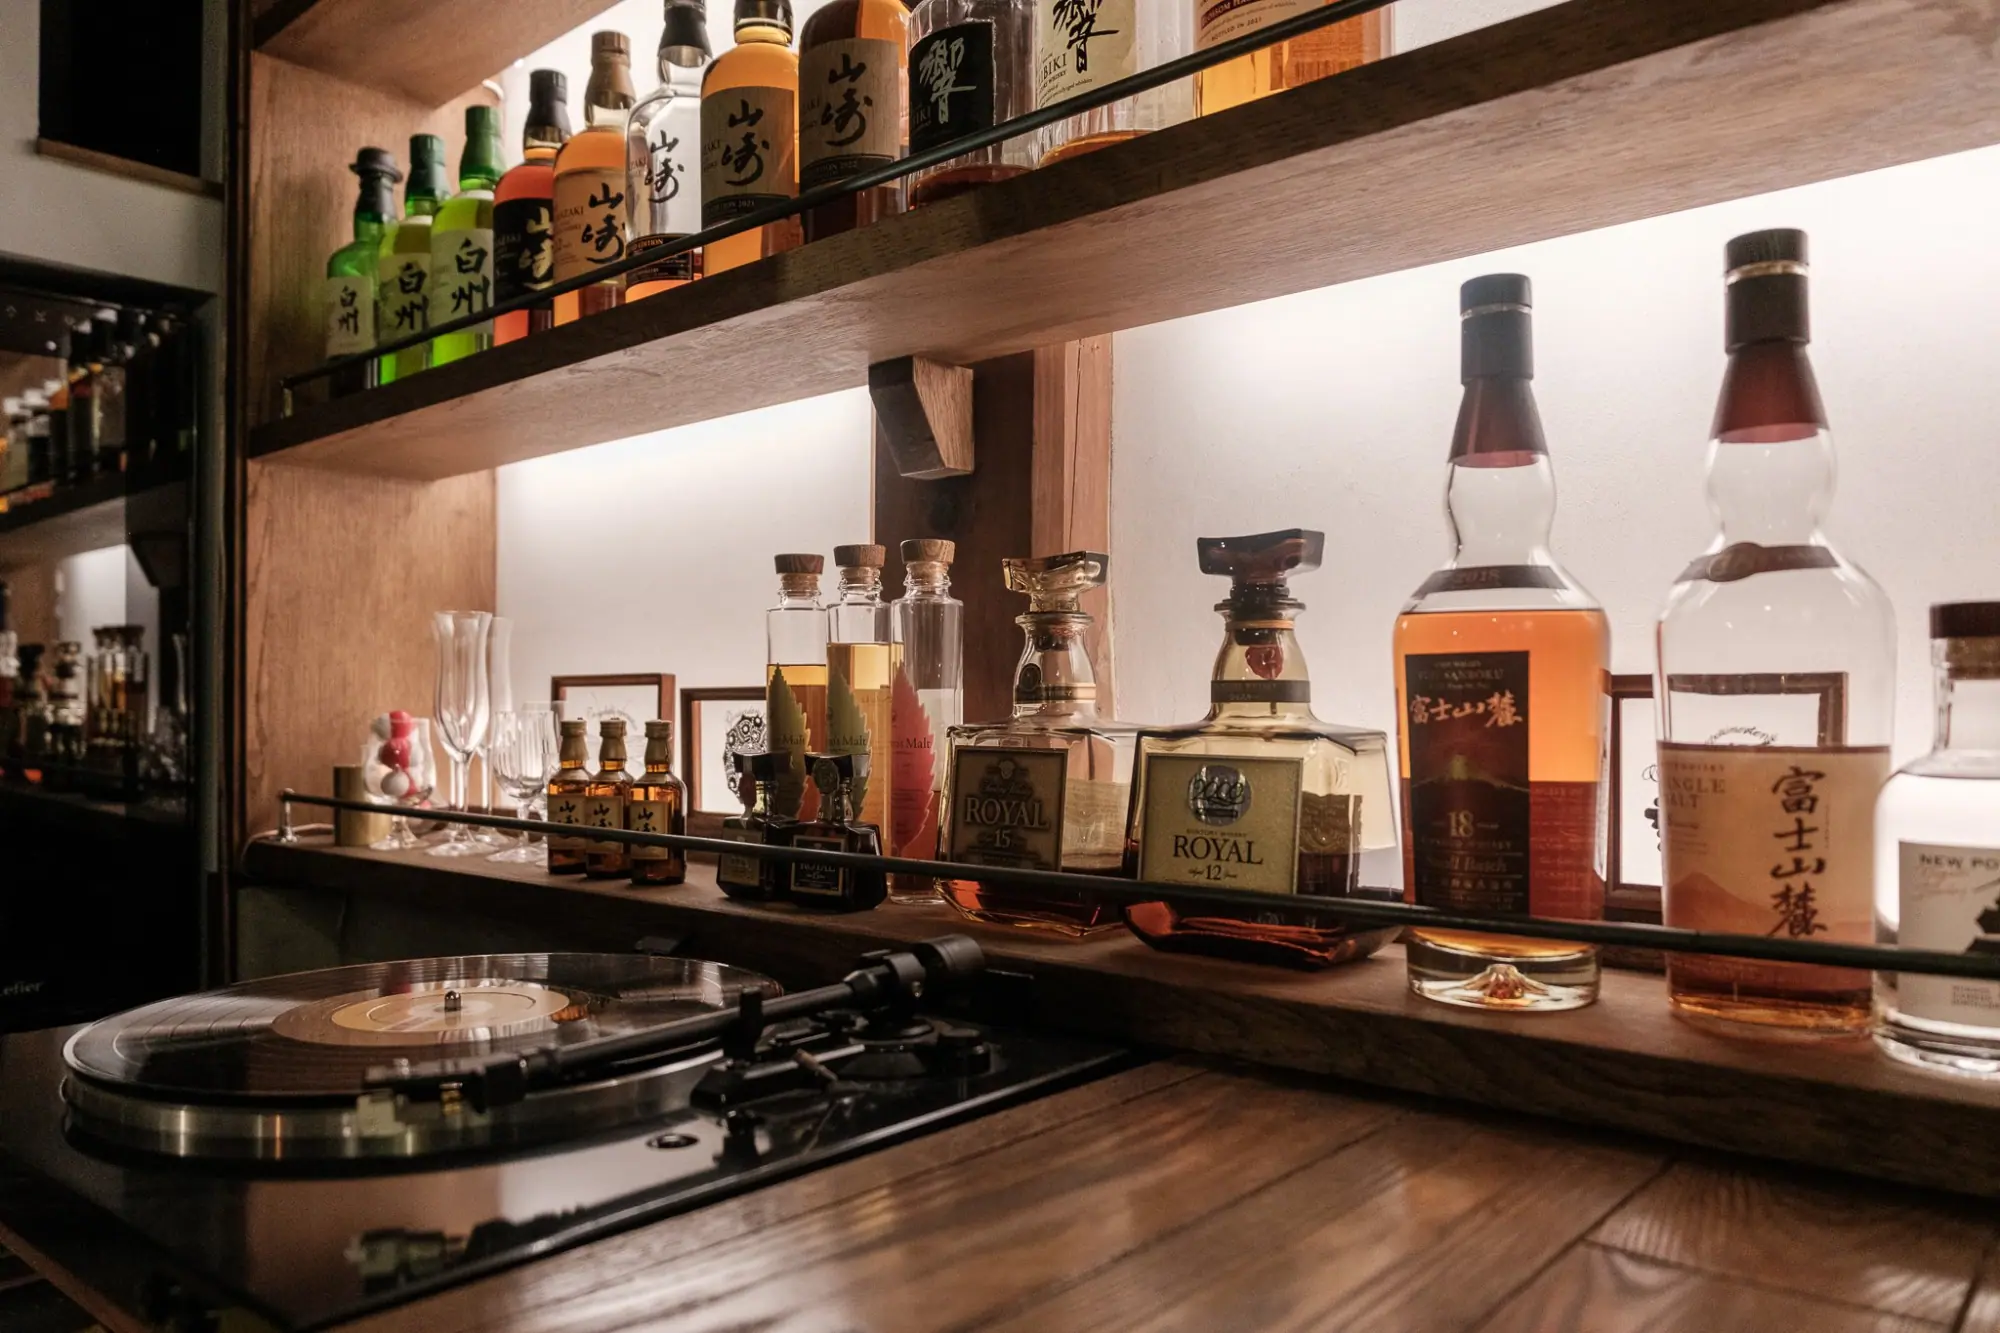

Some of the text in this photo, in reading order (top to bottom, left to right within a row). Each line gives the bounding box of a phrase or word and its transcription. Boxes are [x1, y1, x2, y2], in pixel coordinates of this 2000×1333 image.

[821, 53, 873, 148] 山崎
[721, 98, 770, 187] 山崎
[644, 129, 685, 204] 山崎
[581, 182, 625, 264] 山崎
[450, 238, 489, 314] 白州
[338, 285, 359, 336] 白州
[394, 262, 429, 331] 白州
[1409, 689, 1523, 729] 富士山麓
[842, 735, 867, 746] Malt
[906, 737, 931, 749] Malt
[964, 796, 1050, 830] ROYAL
[1447, 810, 1474, 838] 18
[994, 829, 1011, 848] 15
[1172, 835, 1264, 866] ROYAL
[1764, 766, 1828, 939] 富士山麓
[1205, 864, 1222, 881] 12
[1919, 854, 1964, 869] NEW
